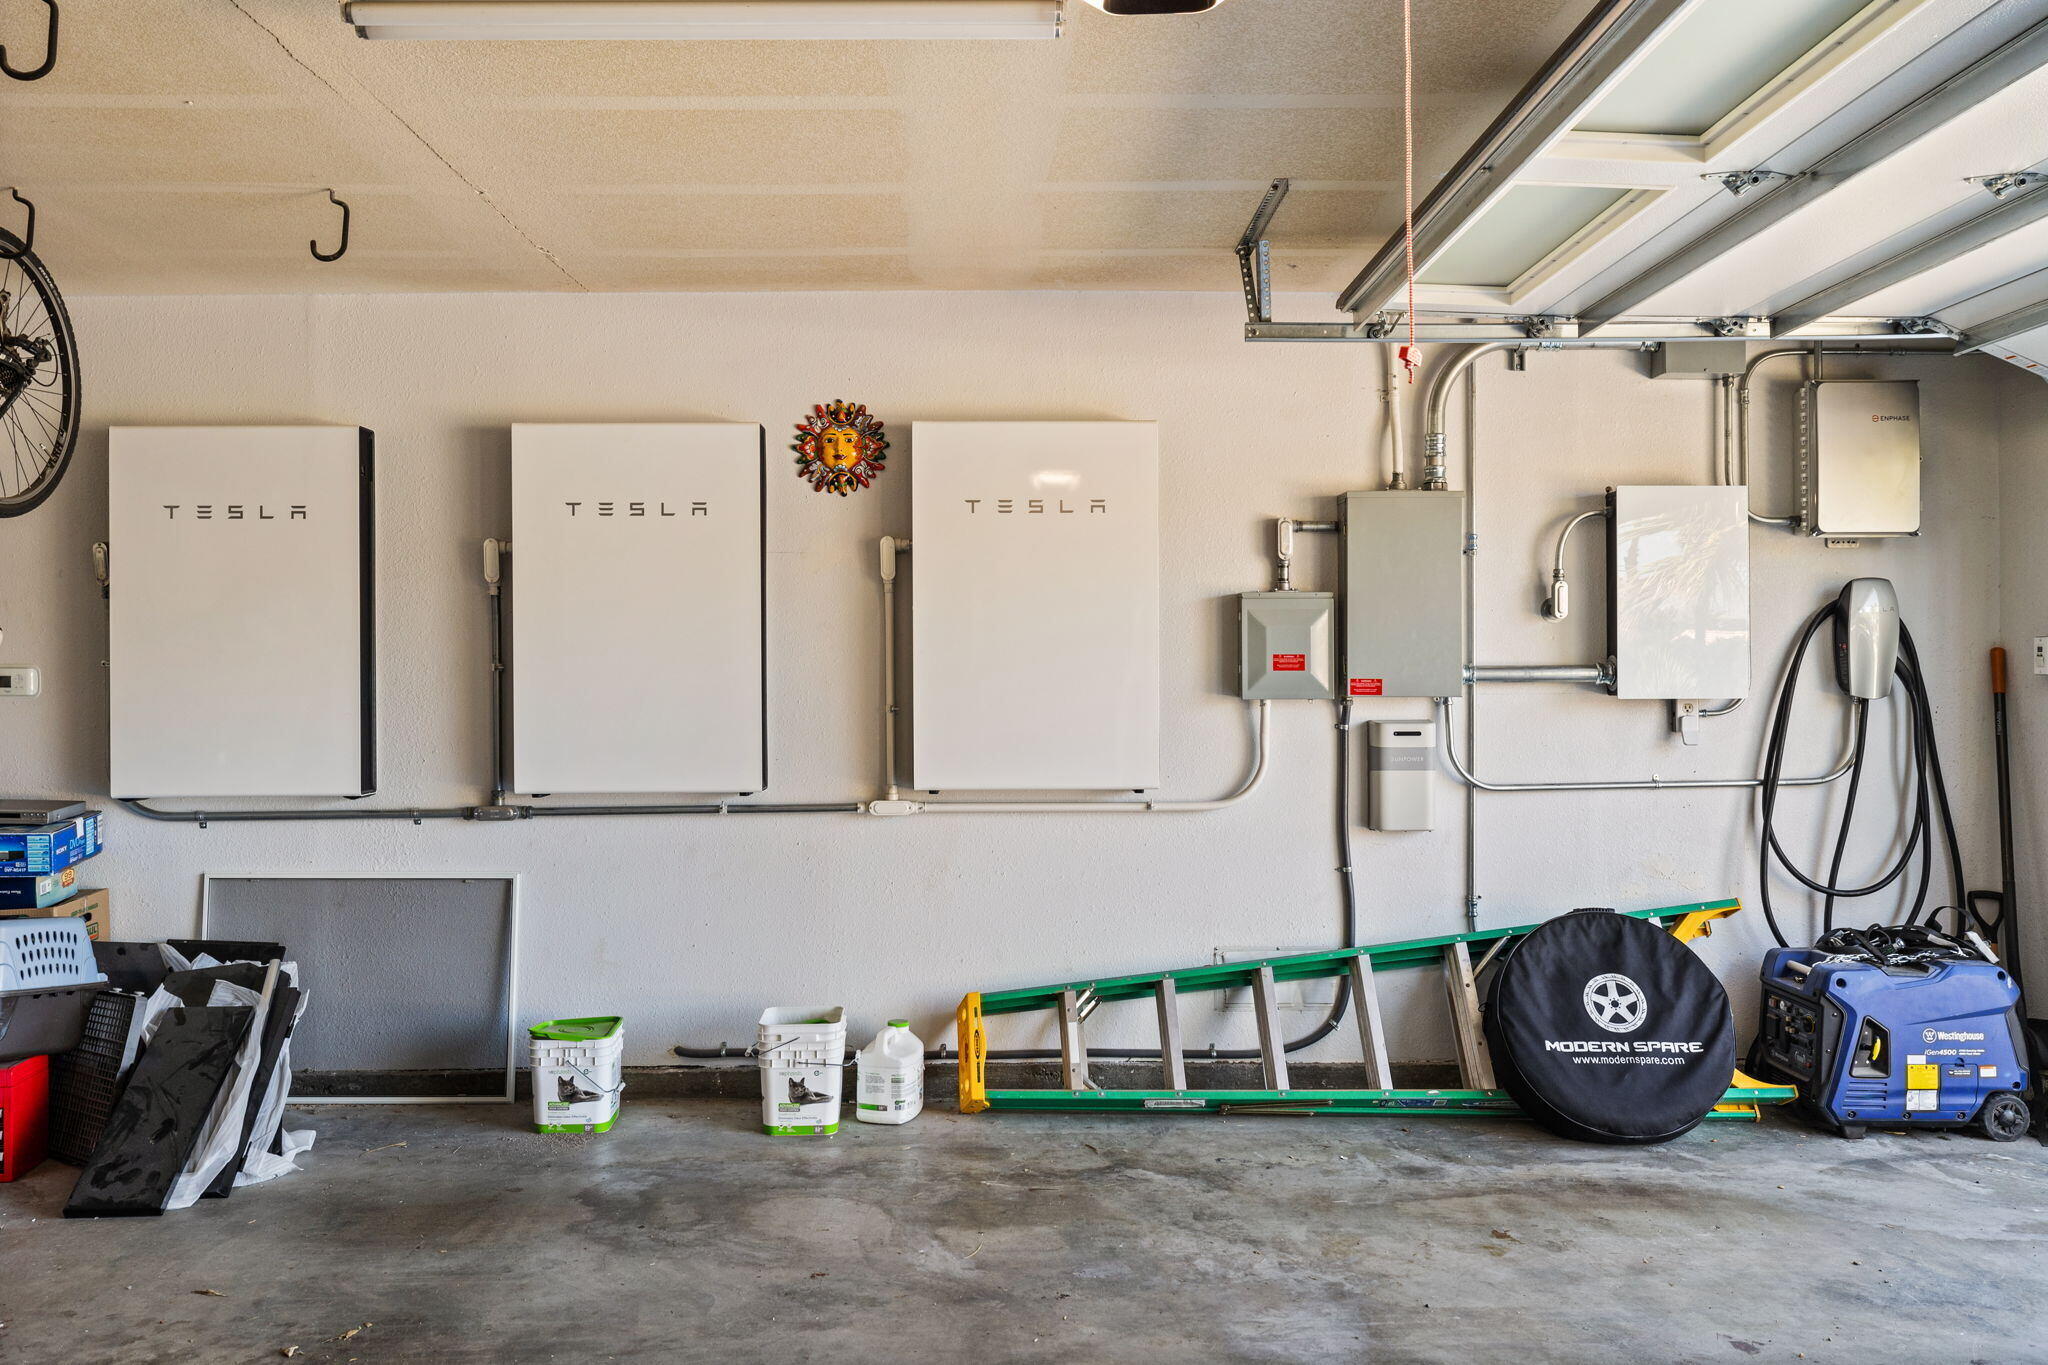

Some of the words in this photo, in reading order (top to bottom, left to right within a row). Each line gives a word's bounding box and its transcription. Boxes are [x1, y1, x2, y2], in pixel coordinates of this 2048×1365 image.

[163, 505, 306, 519] TESLA
[565, 502, 707, 516] TESLA
[964, 499, 1106, 513] TESLA
[56, 845, 67, 855] SONY
[1937, 1031, 1984, 1042] Westinghouse
[1544, 1040, 1630, 1052] MODERN
[1632, 1041, 1704, 1053] SPARE
[1572, 1055, 1685, 1066] www.modernspare.com
